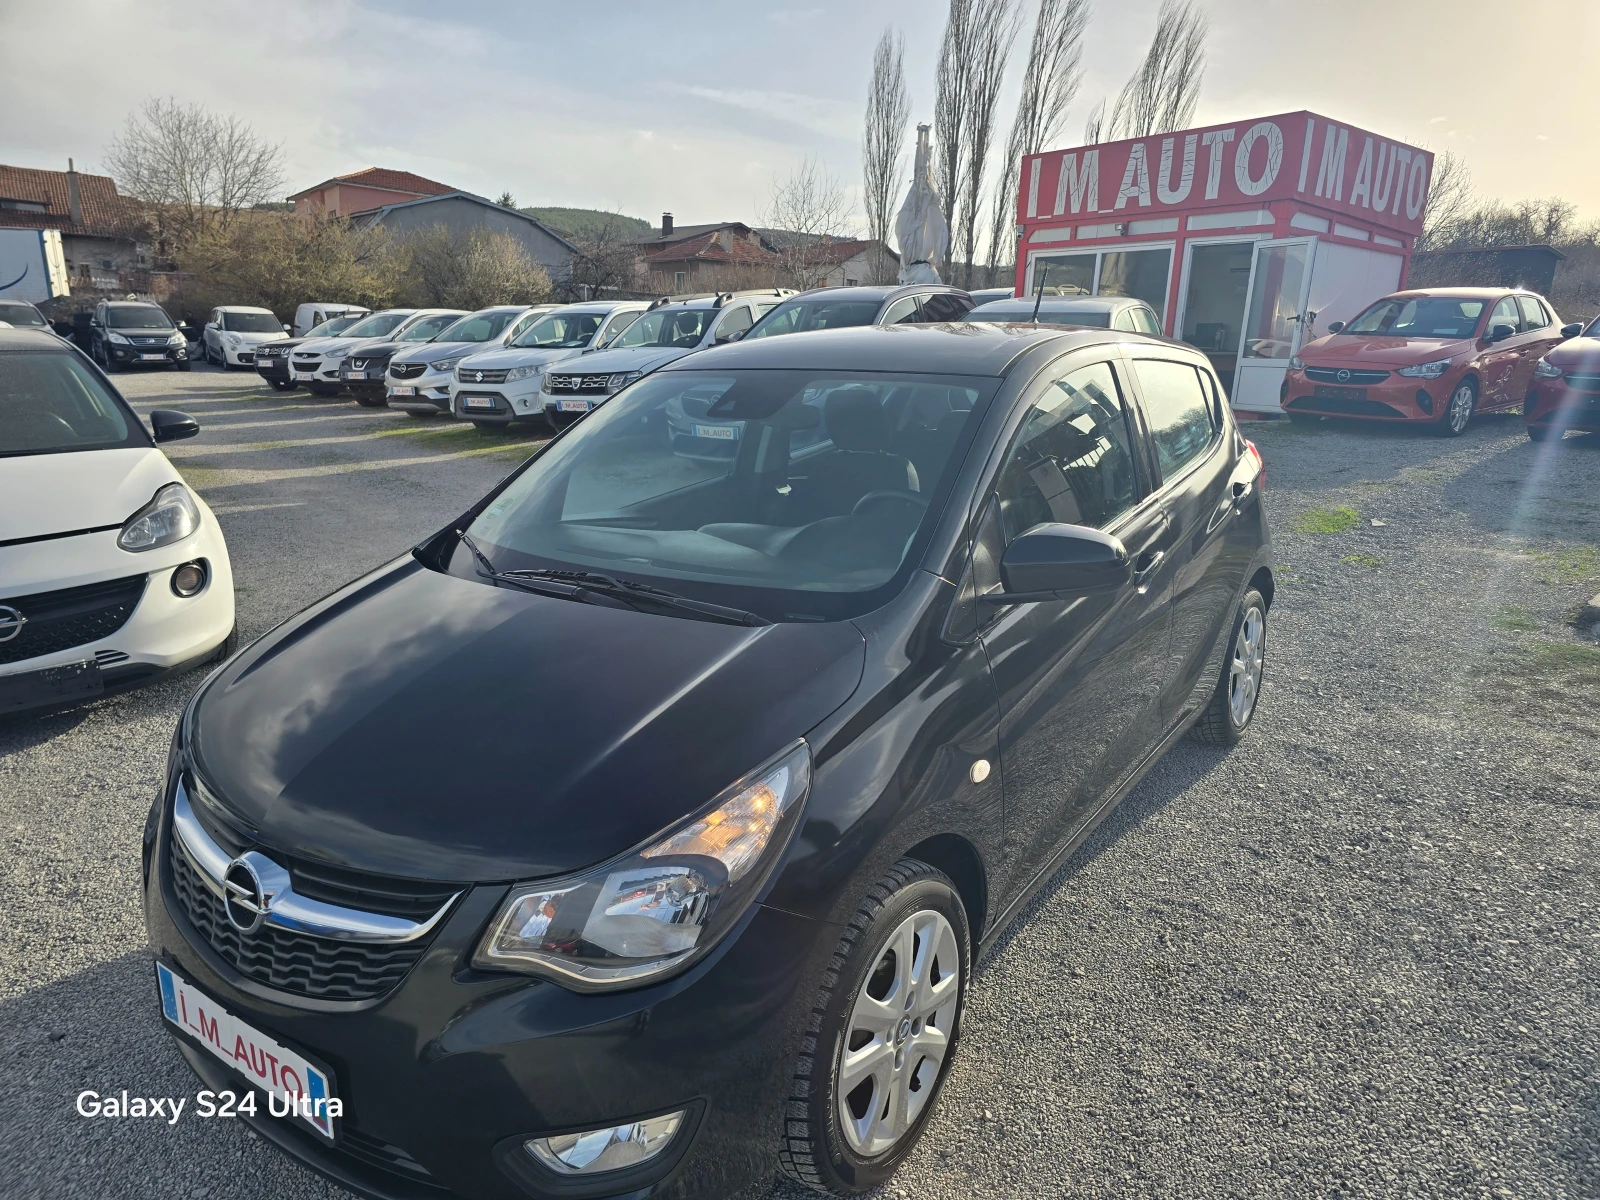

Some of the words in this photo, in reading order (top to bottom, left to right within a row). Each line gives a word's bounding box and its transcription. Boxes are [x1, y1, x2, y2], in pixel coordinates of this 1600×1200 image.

[1297, 118, 1315, 193] I
[1315, 123, 1349, 201] M
[1349, 137, 1428, 221] AUTO
